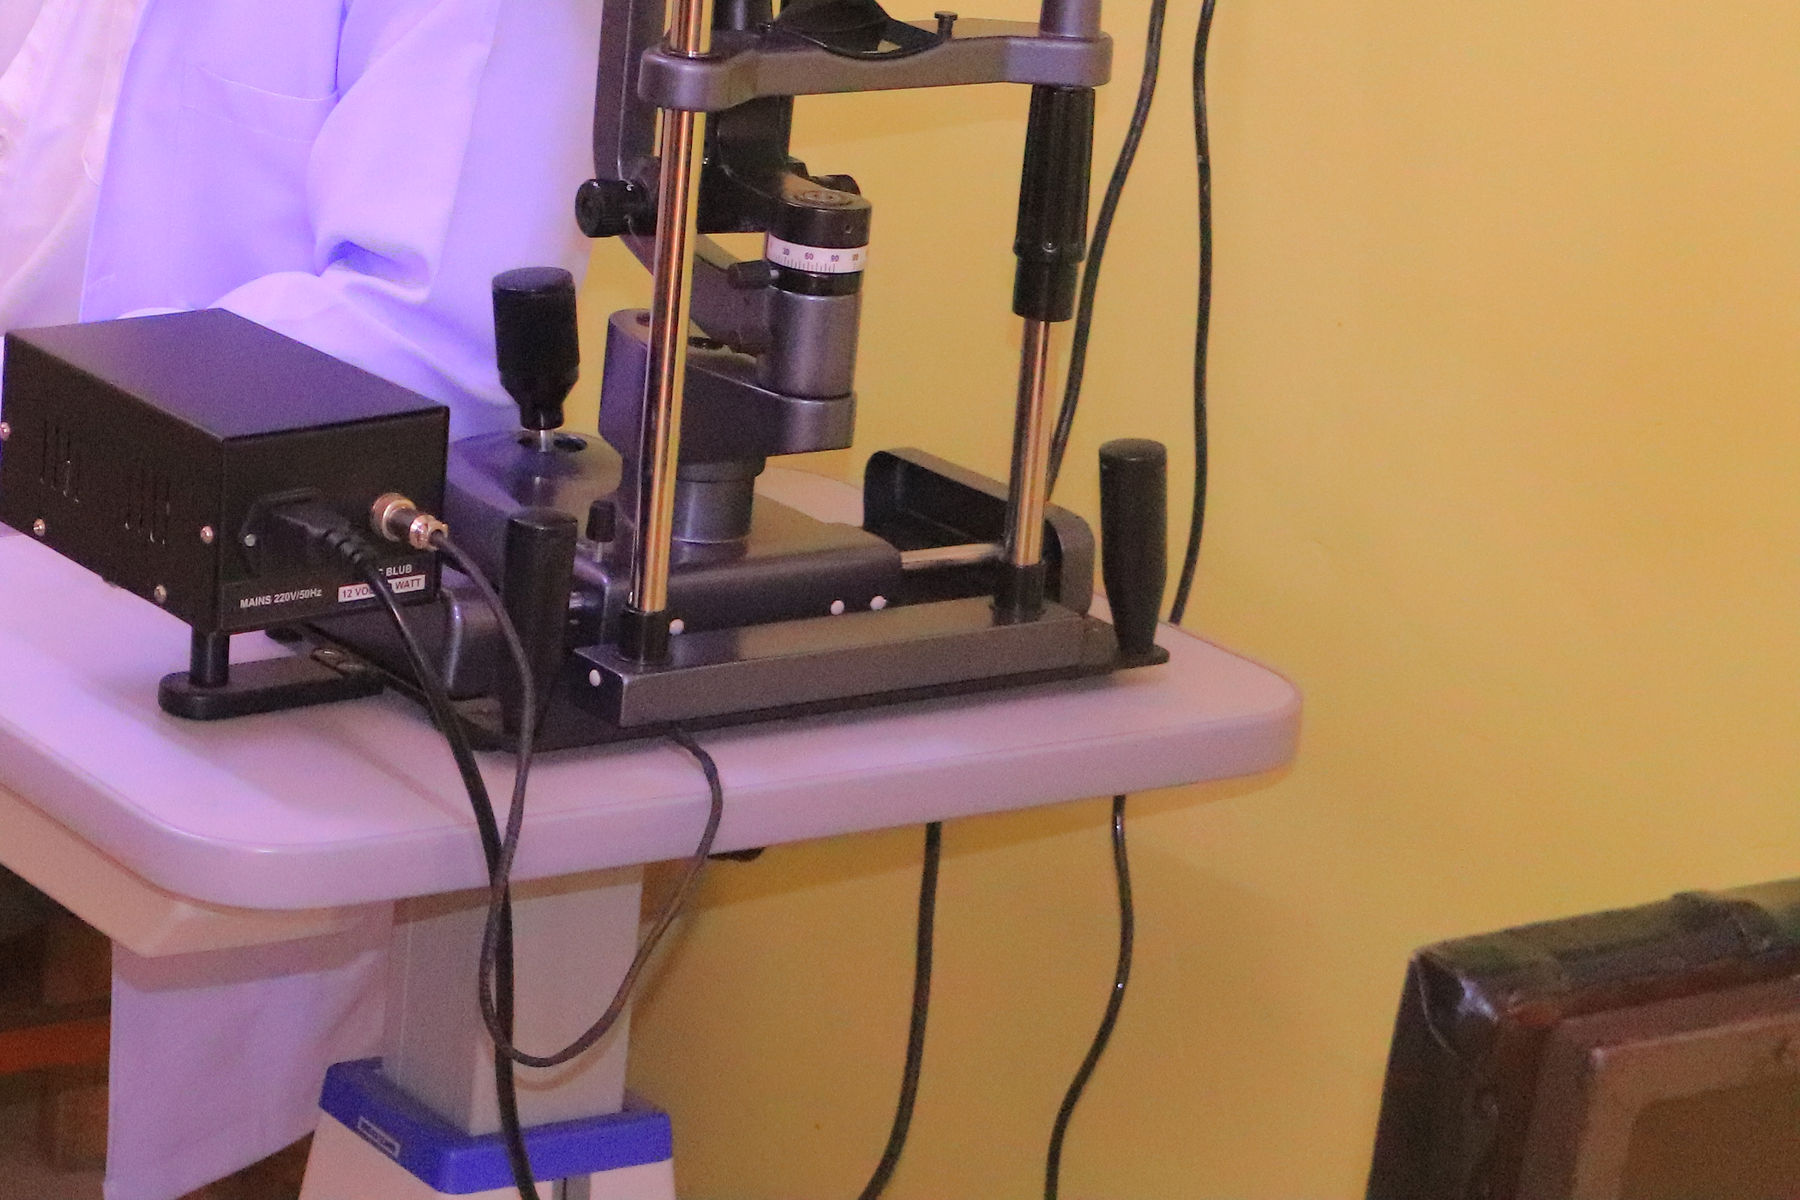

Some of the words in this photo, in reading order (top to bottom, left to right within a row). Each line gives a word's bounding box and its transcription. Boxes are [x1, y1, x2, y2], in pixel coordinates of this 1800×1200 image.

[804, 252, 814, 261] 60
[386, 564, 413, 577] BLUB
[343, 589, 353, 599] 12
[395, 578, 422, 590] WATT
[240, 595, 272, 609] MAINS
[273, 588, 323, 604] 220V/50Hz
